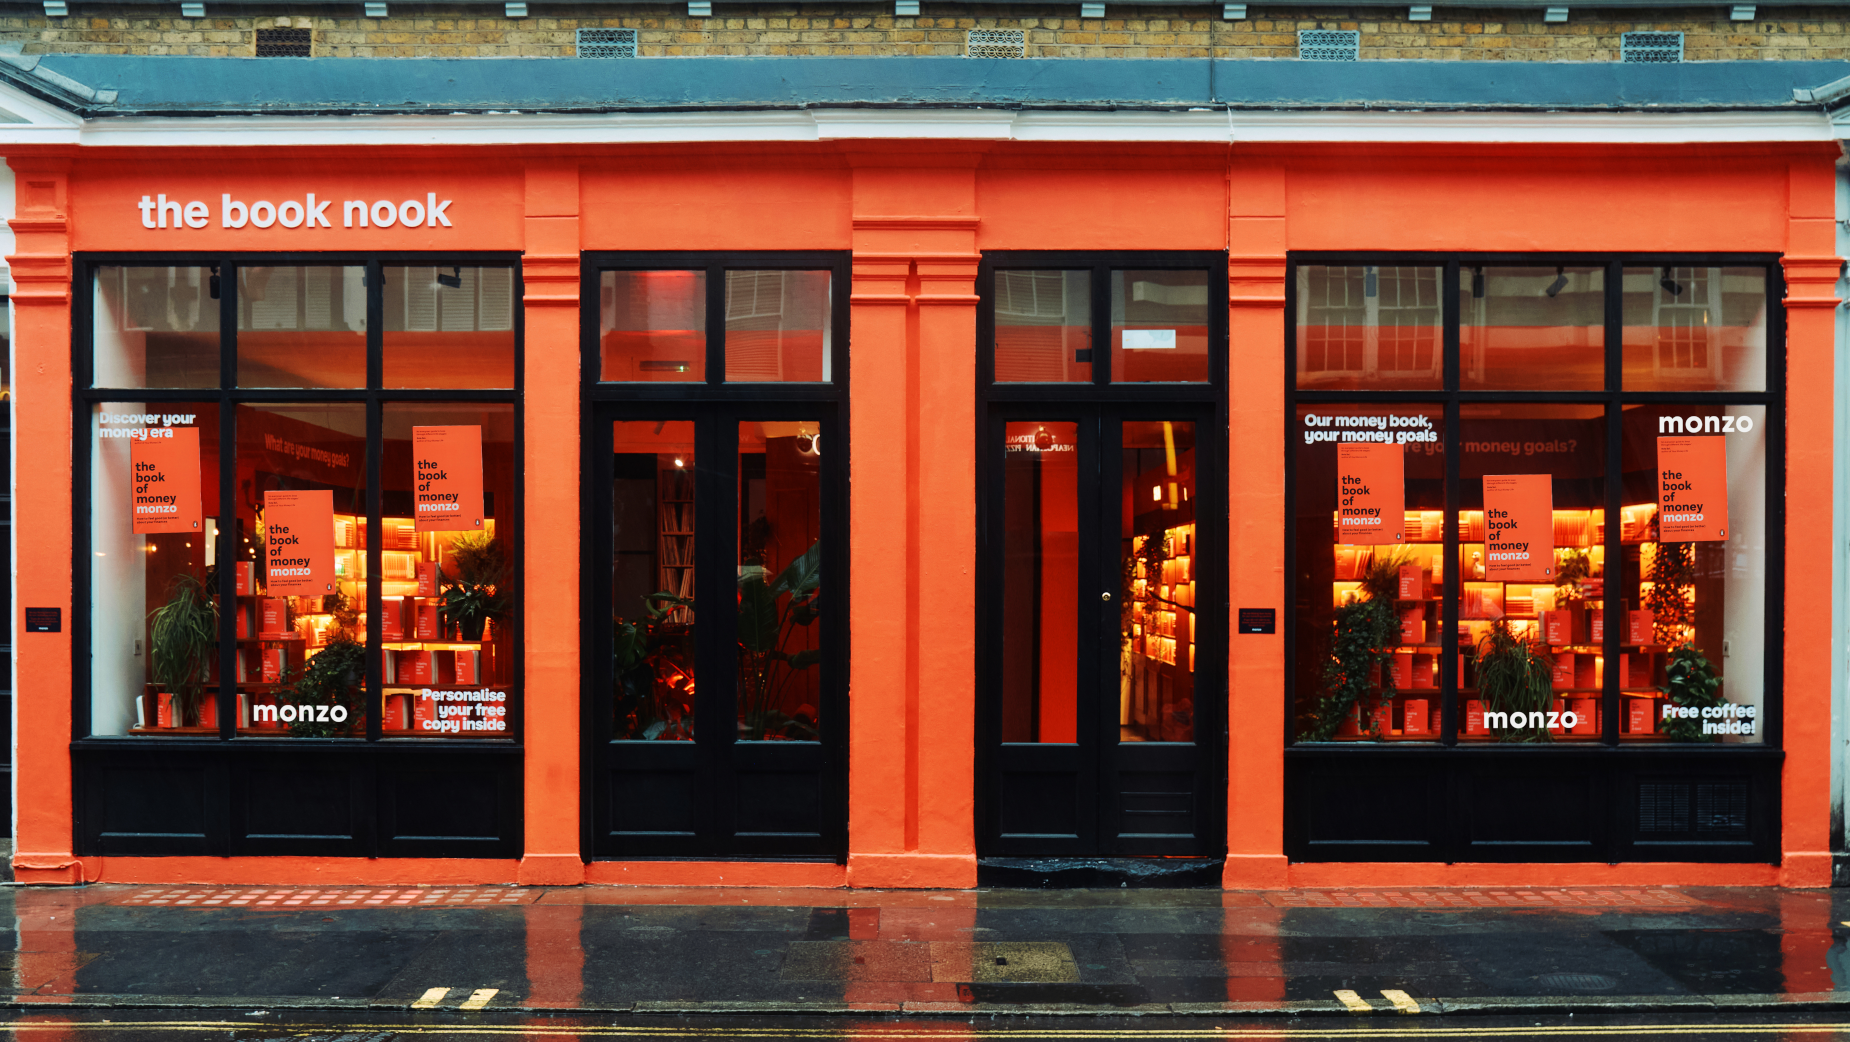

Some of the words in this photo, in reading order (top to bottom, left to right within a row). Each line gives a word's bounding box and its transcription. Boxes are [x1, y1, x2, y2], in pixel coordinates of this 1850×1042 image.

[138, 193, 209, 228] the
[221, 193, 332, 228] book
[343, 192, 453, 228] nook
[99, 412, 160, 424] Discover
[162, 414, 196, 427] your
[1304, 413, 1333, 427] Our
[1335, 415, 1387, 430] money
[1389, 414, 1433, 429] book,
[1659, 415, 1754, 434] monzo
[99, 428, 148, 441] money
[150, 428, 173, 438] era
[1304, 430, 1340, 444] your
[1341, 430, 1394, 444] money
[1396, 429, 1438, 444] goals
[264, 433, 283, 452] What
[284, 441, 295, 456] are
[295, 444, 311, 460] your
[311, 448, 331, 465] money
[331, 453, 350, 468] goals?
[1404, 442, 1421, 453] re
[1465, 441, 1521, 456] money
[1523, 439, 1577, 456] goals?
[136, 462, 156, 471] the
[417, 459, 438, 469] the
[136, 472, 165, 483] book
[418, 470, 447, 480] book
[1342, 475, 1361, 485] the
[1662, 470, 1683, 480] the
[136, 484, 148, 494] of
[418, 482, 431, 491] of
[1342, 486, 1370, 495] book
[1663, 481, 1692, 491] book
[136, 495, 177, 505] money
[419, 493, 459, 503] money
[1342, 496, 1354, 506] of
[1663, 492, 1675, 502] of
[136, 505, 177, 514] monzo
[419, 503, 459, 512] monzo
[1342, 508, 1381, 517] money
[1663, 504, 1703, 513] money
[1488, 509, 1508, 518] the
[1663, 513, 1704, 522] monzo
[1342, 517, 1382, 526] monzo
[1488, 519, 1518, 530] book
[269, 524, 289, 534] the
[269, 535, 299, 545] book
[1488, 531, 1501, 540] of
[270, 546, 282, 556] of
[1489, 542, 1529, 552] money
[1489, 552, 1530, 561] monzo
[270, 558, 311, 568] money
[270, 567, 311, 577] monzo
[422, 688, 507, 702] Personalise
[253, 704, 348, 723] monzo
[438, 705, 473, 718] your
[475, 703, 507, 716] free
[1662, 704, 1699, 719] Free
[1701, 703, 1757, 719] coffee
[422, 719, 461, 733] copy
[462, 717, 507, 731] inside
[1483, 711, 1578, 729] monzo
[1702, 719, 1756, 735] inside!
